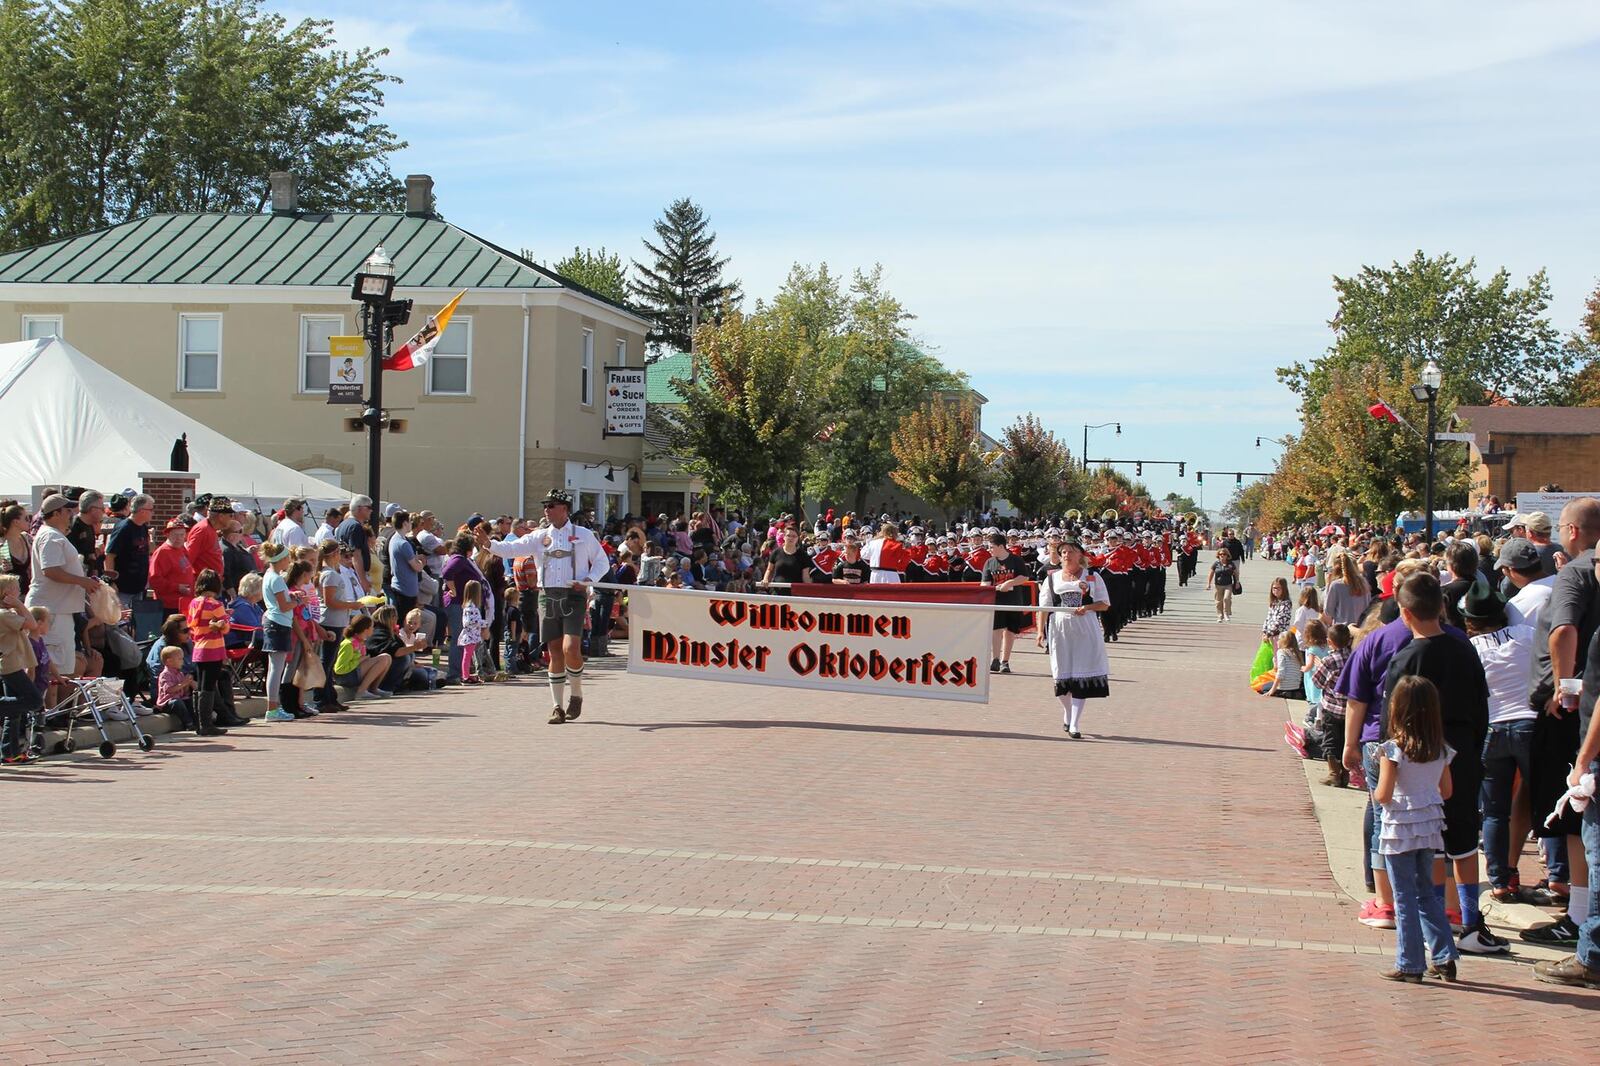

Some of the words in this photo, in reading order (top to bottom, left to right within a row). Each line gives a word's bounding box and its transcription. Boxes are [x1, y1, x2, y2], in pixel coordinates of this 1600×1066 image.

[611, 373, 641, 383] FRAMES
[622, 390, 644, 400] SUCH
[708, 599, 912, 640] Willkommen
[1472, 628, 1514, 649] PINK
[642, 630, 772, 672] Minster
[788, 642, 978, 688] Oktoberfest
